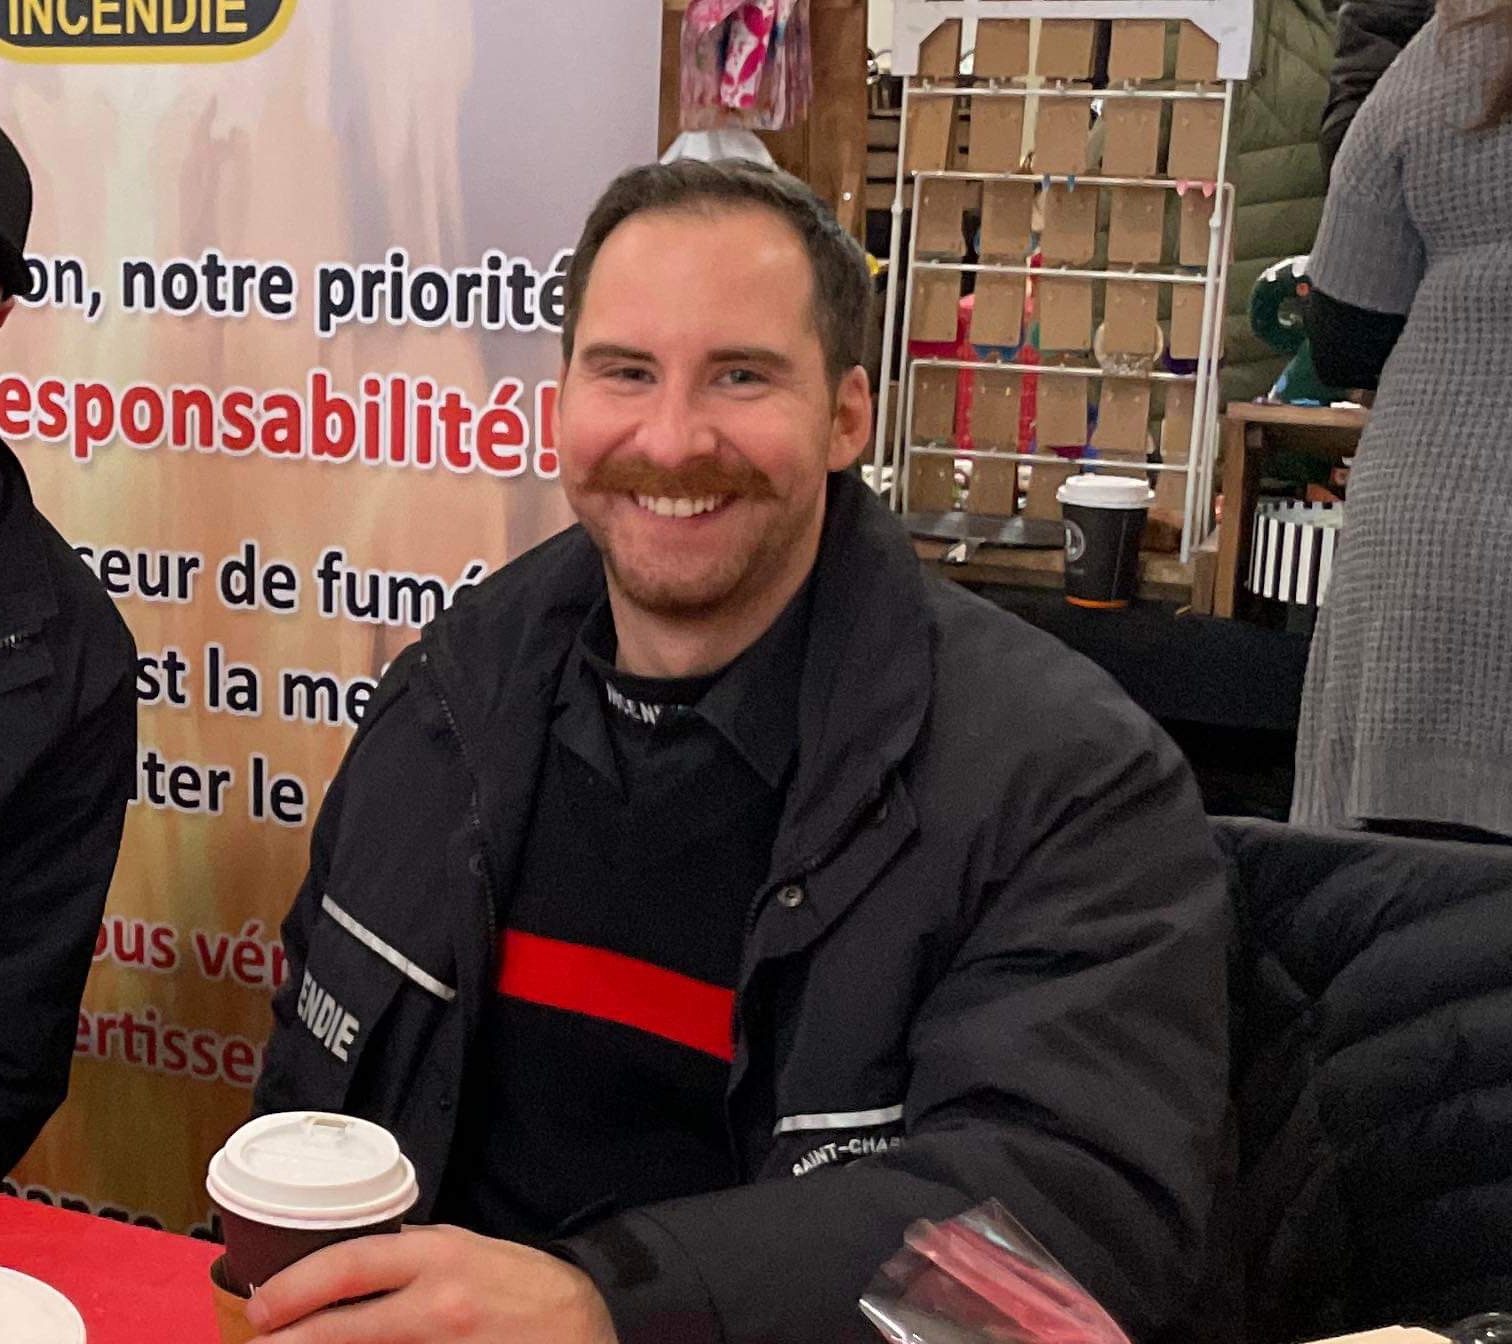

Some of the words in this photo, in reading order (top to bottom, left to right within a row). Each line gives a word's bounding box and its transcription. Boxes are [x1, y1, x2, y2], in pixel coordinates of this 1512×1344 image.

[123, 253, 293, 317] notre
[220, 544, 296, 610] de
[208, 647, 258, 712] la
[253, 758, 304, 823] le
[298, 969, 360, 1062] ENDIE
